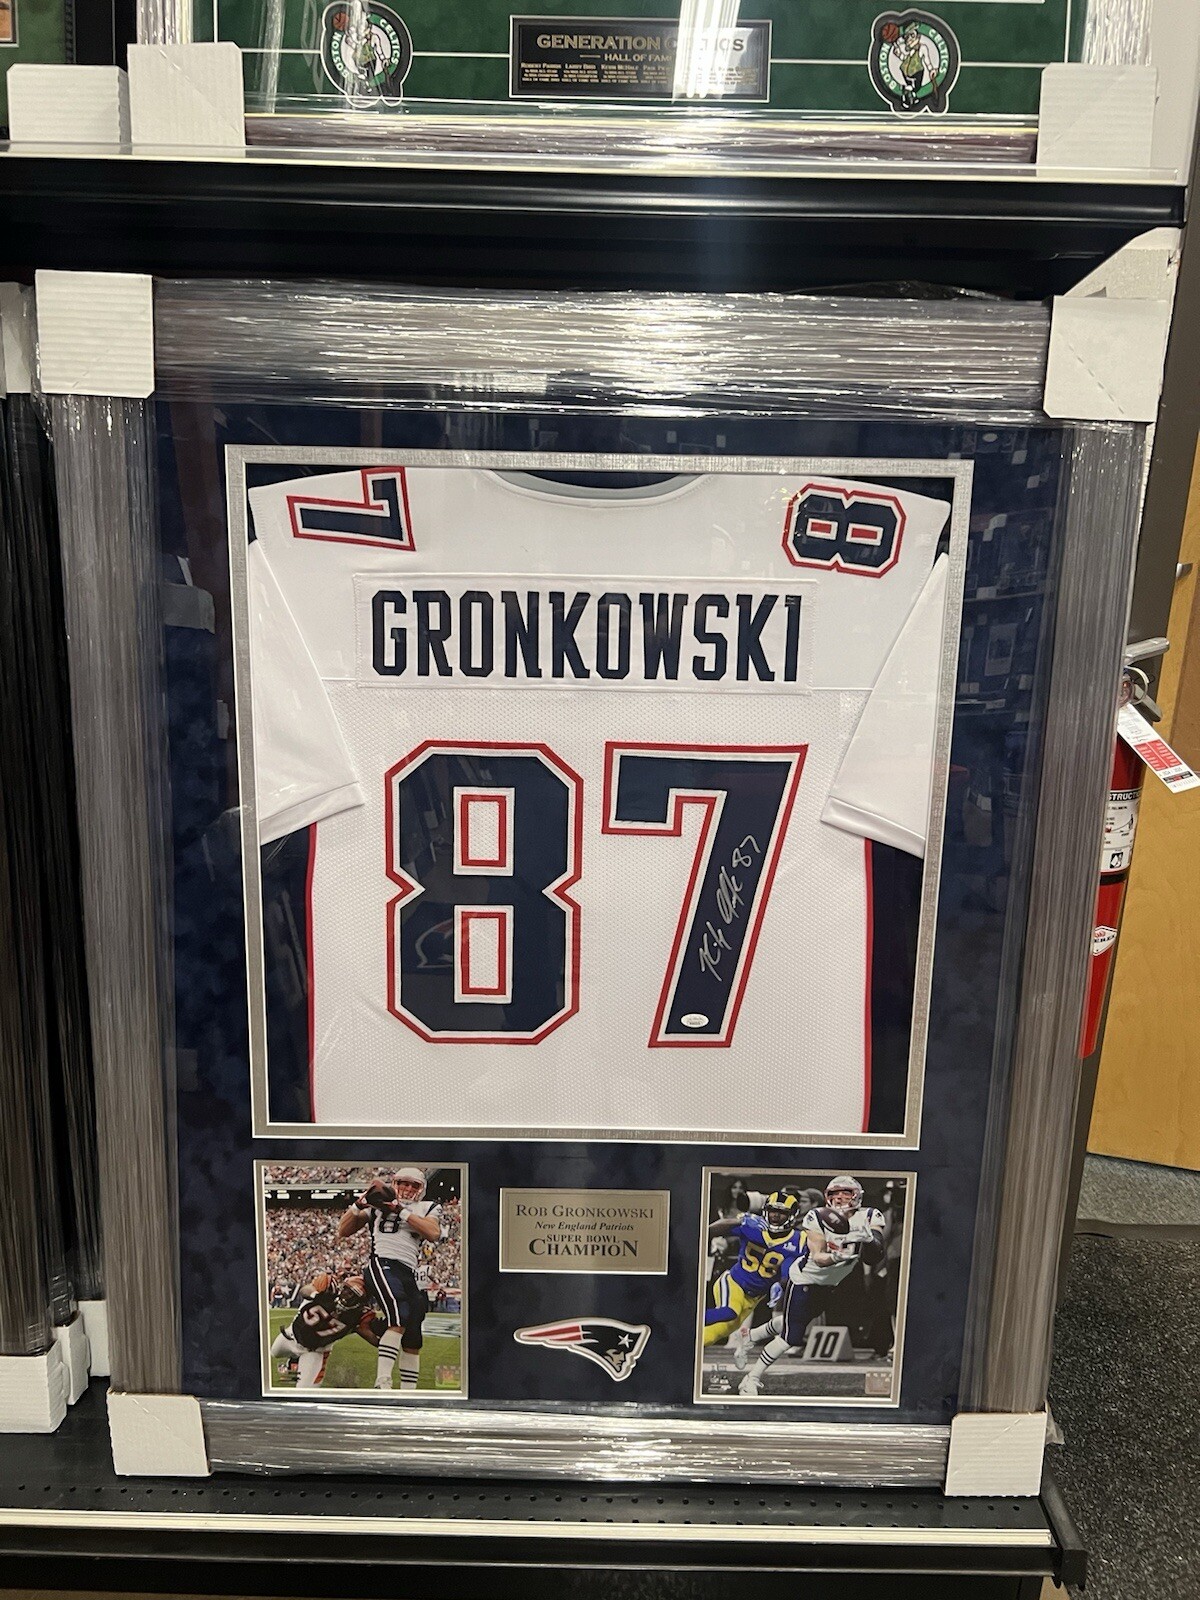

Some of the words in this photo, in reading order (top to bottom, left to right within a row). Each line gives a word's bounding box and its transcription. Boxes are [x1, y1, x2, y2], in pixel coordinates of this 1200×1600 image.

[379, 18, 401, 65] CELTICS
[537, 34, 661, 50] GENERATION
[604, 53, 631, 61] HALL
[633, 54, 646, 62] OF
[928, 28, 949, 74] CELTICS
[879, 42, 898, 90] BOSTON
[287, 466, 416, 552] 7
[782, 483, 907, 579] 8
[371, 590, 802, 681] GRONKOWSKI
[385, 740, 808, 1048] 87
[516, 1205, 548, 1217] ROB
[552, 1205, 654, 1219] GRONKOWSKI
[534, 1221, 556, 1230] New
[557, 1221, 597, 1231] England
[599, 1222, 634, 1231] Patriots
[528, 1238, 638, 1257] CHAMPION
[546, 1234, 582, 1243] SUPER
[586, 1235, 620, 1243] BOWL
[741, 1241, 785, 1278] 58
[302, 1305, 346, 1337] 57
[810, 1331, 841, 1358] 10
